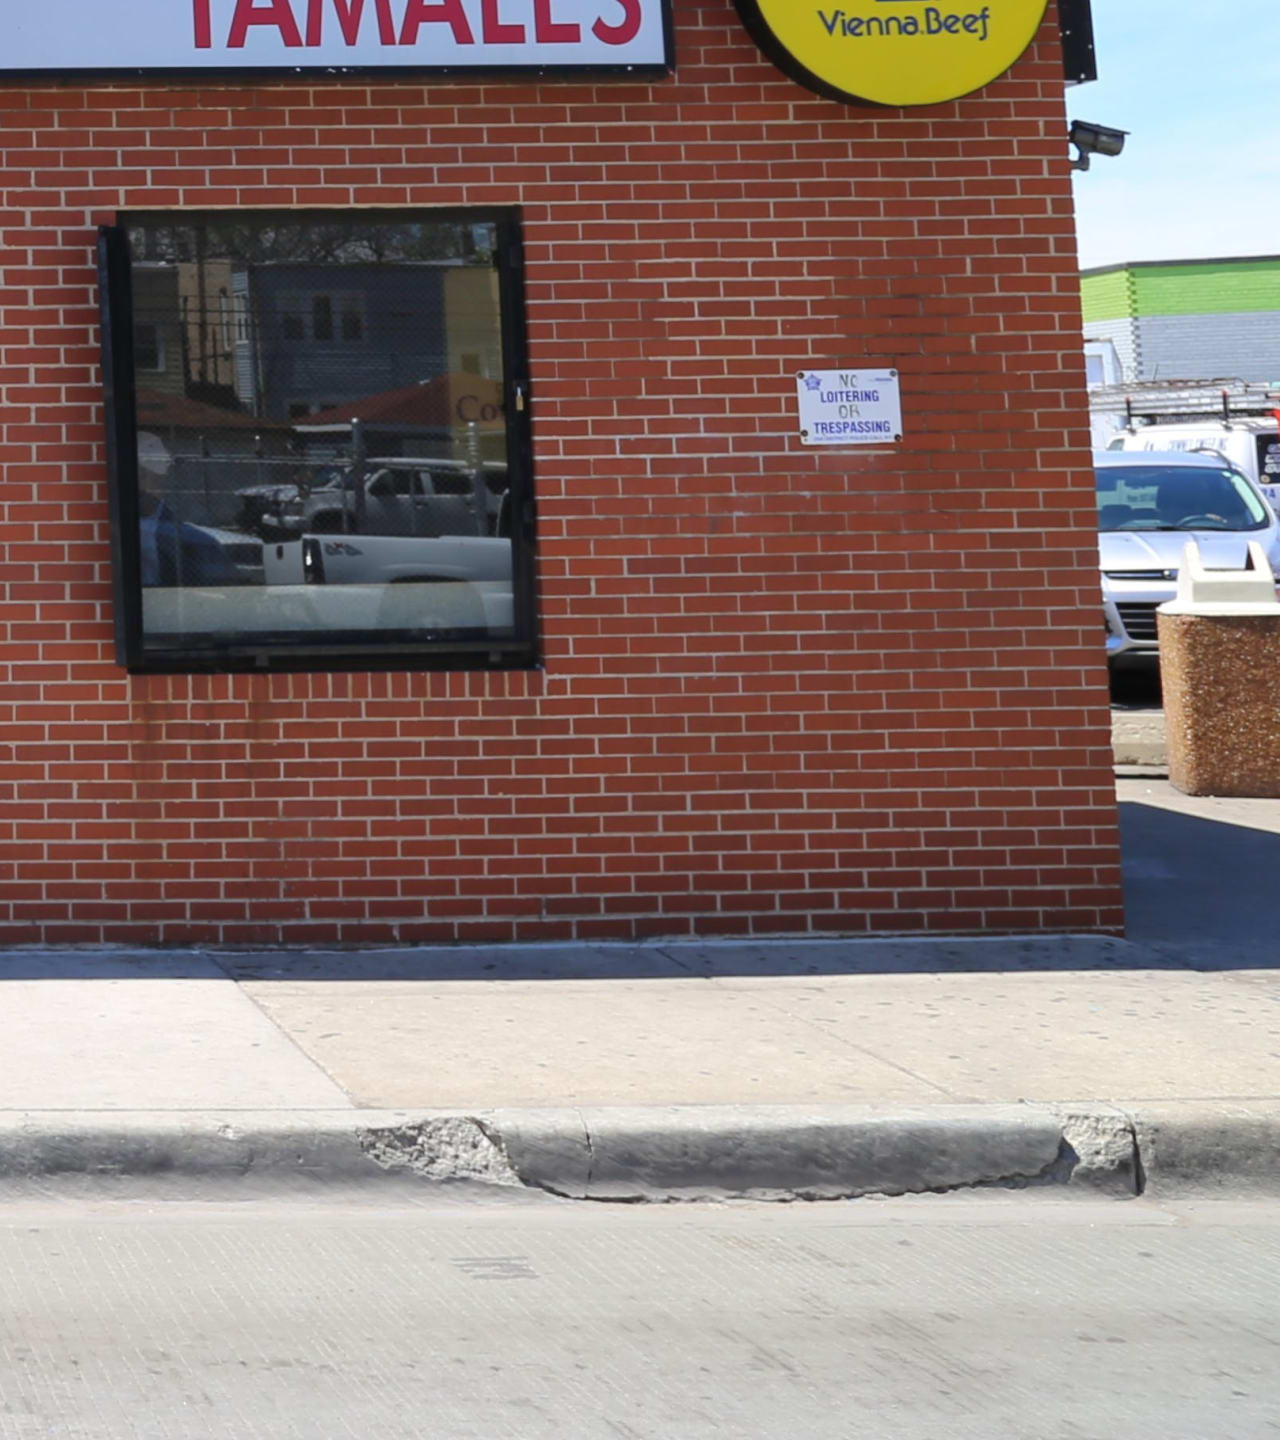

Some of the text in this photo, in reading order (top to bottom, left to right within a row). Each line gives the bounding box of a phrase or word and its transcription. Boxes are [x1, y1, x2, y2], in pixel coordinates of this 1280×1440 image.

[817, 6, 991, 42] Vienna Beef
[820, 390, 880, 403] LOITERING
[838, 404, 860, 419] OR
[813, 420, 891, 434] TRESPASSING
